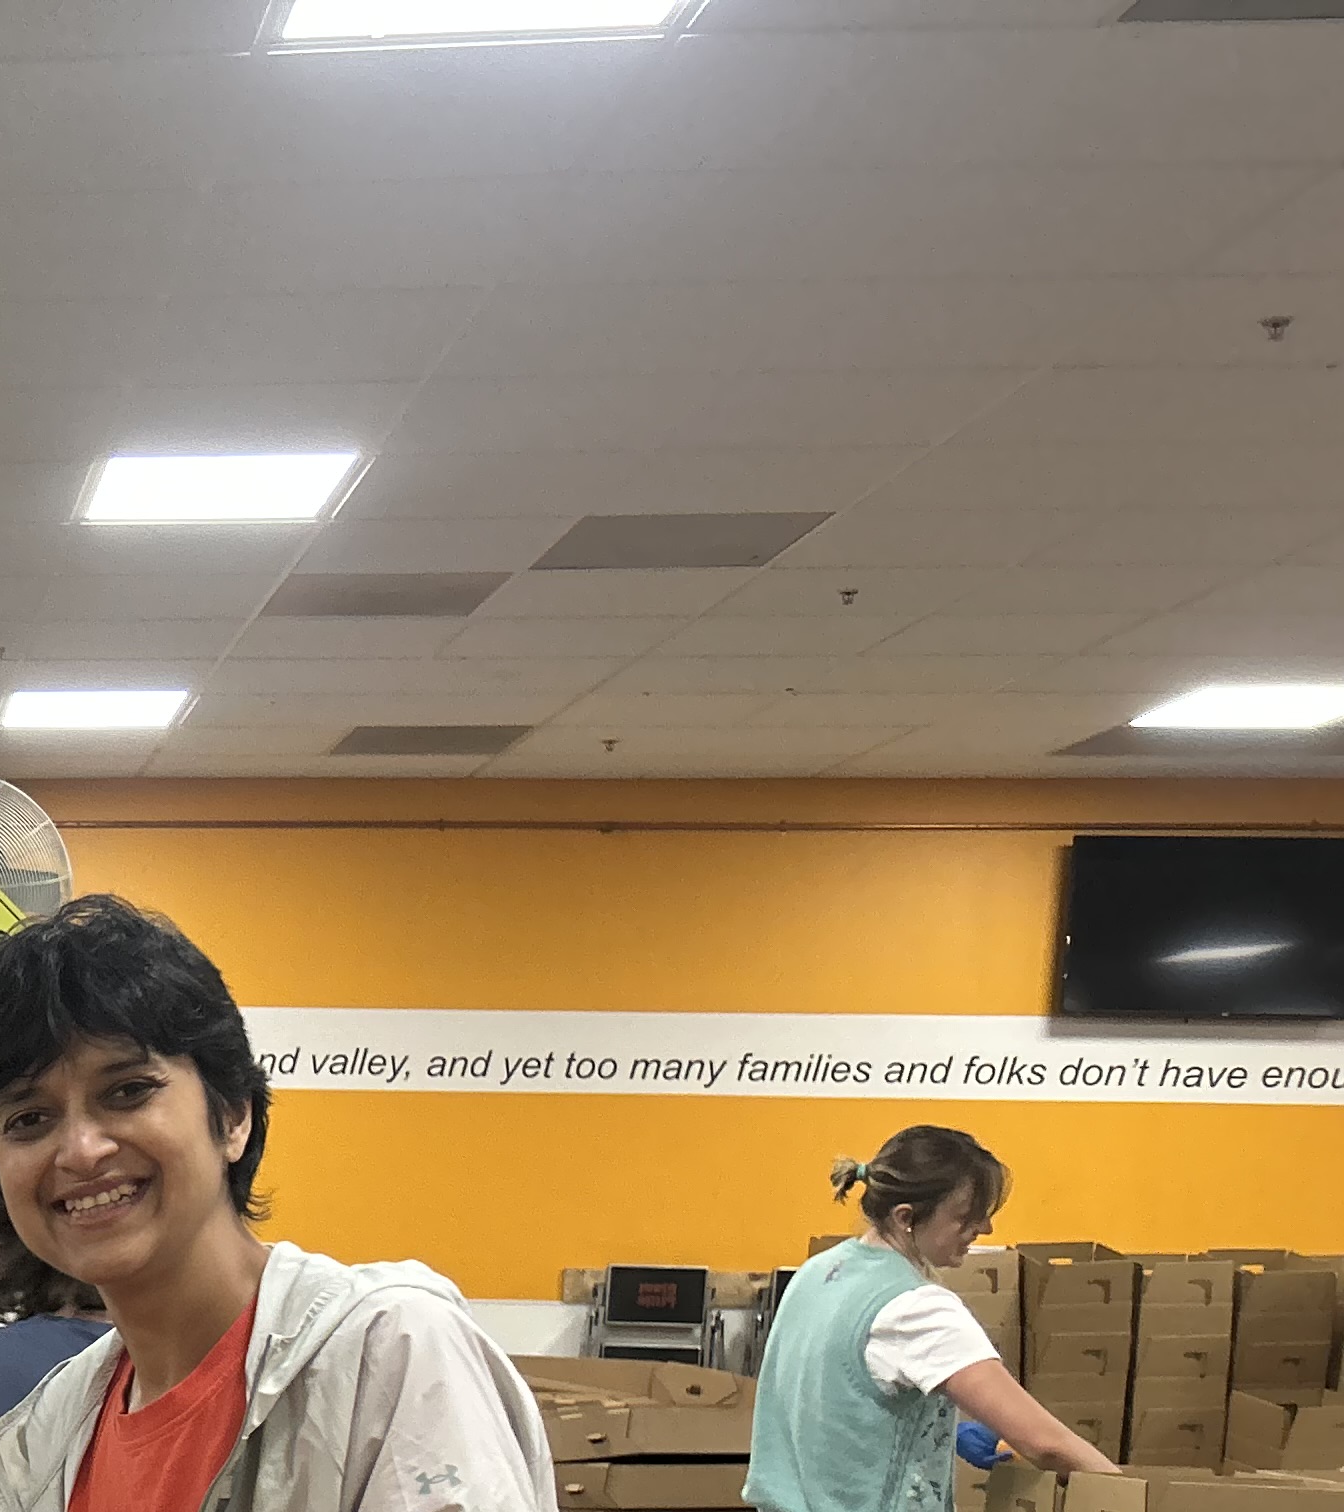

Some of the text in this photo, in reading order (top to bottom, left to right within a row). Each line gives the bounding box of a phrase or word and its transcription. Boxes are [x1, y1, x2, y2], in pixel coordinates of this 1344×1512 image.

[312, 1048, 410, 1084] valley,
[427, 1051, 493, 1079] and
[500, 1053, 554, 1085] yet
[565, 1054, 618, 1081] too
[629, 1058, 727, 1088] many
[736, 1053, 872, 1084] families
[884, 1056, 954, 1086] and
[963, 1056, 1046, 1086] folks
[1059, 1057, 1149, 1088] don’t
[1159, 1059, 1248, 1089] have
